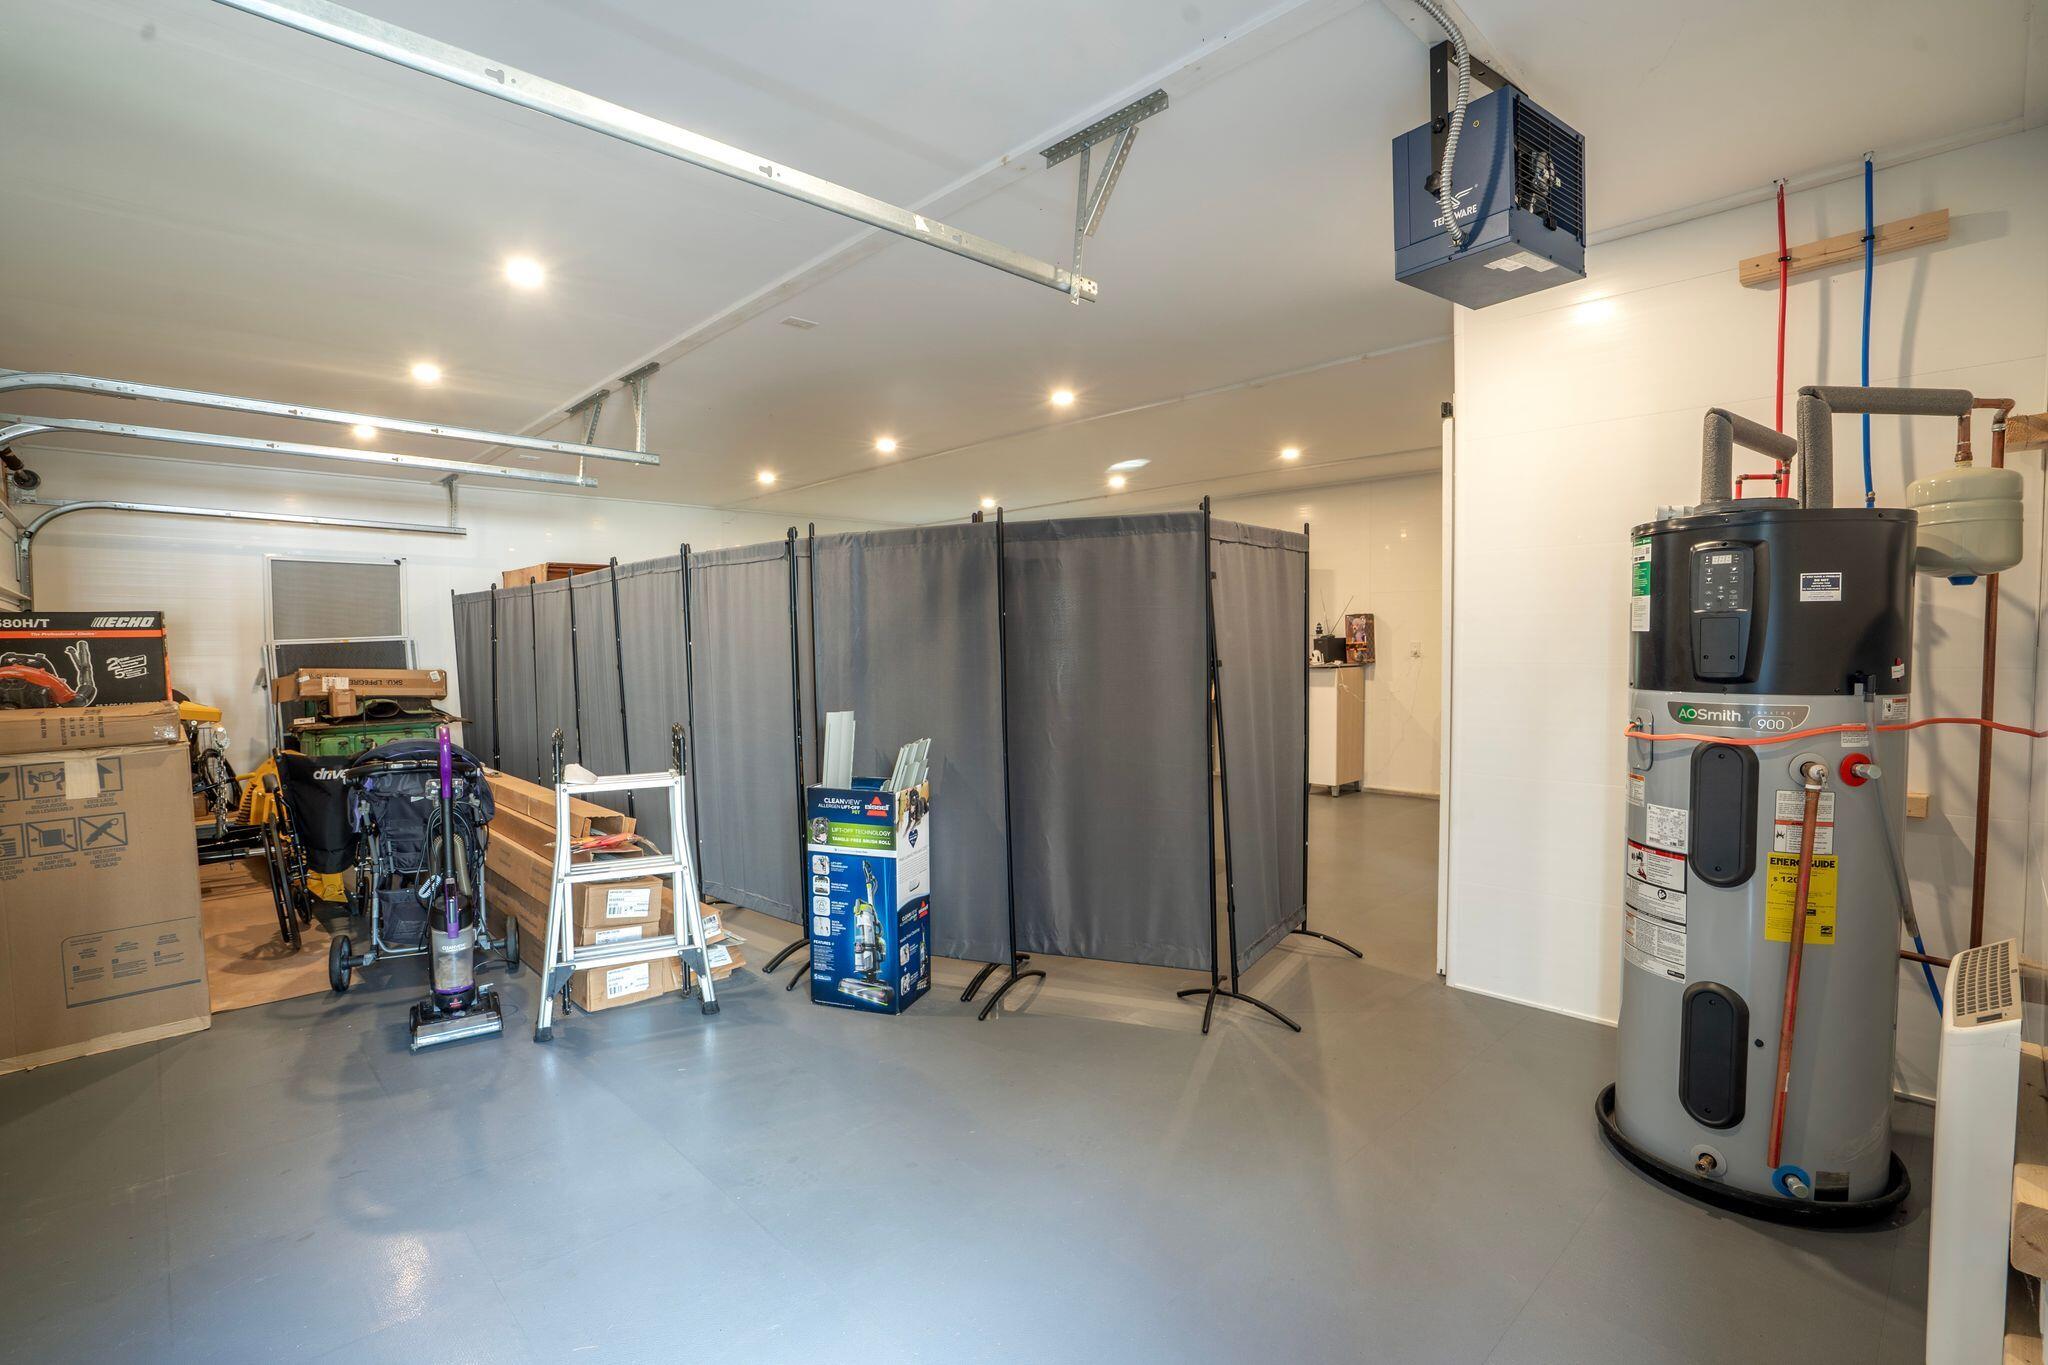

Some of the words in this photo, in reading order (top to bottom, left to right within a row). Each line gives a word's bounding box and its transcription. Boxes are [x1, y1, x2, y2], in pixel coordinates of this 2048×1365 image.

[0, 618, 50, 628] 80H/T
[104, 616, 155, 628] ECHO
[106, 657, 120, 672] 2
[1757, 719, 1785, 730] 900
[823, 797, 860, 805] CLEANVIEW
[855, 829, 891, 837] TECHNOLOGY
